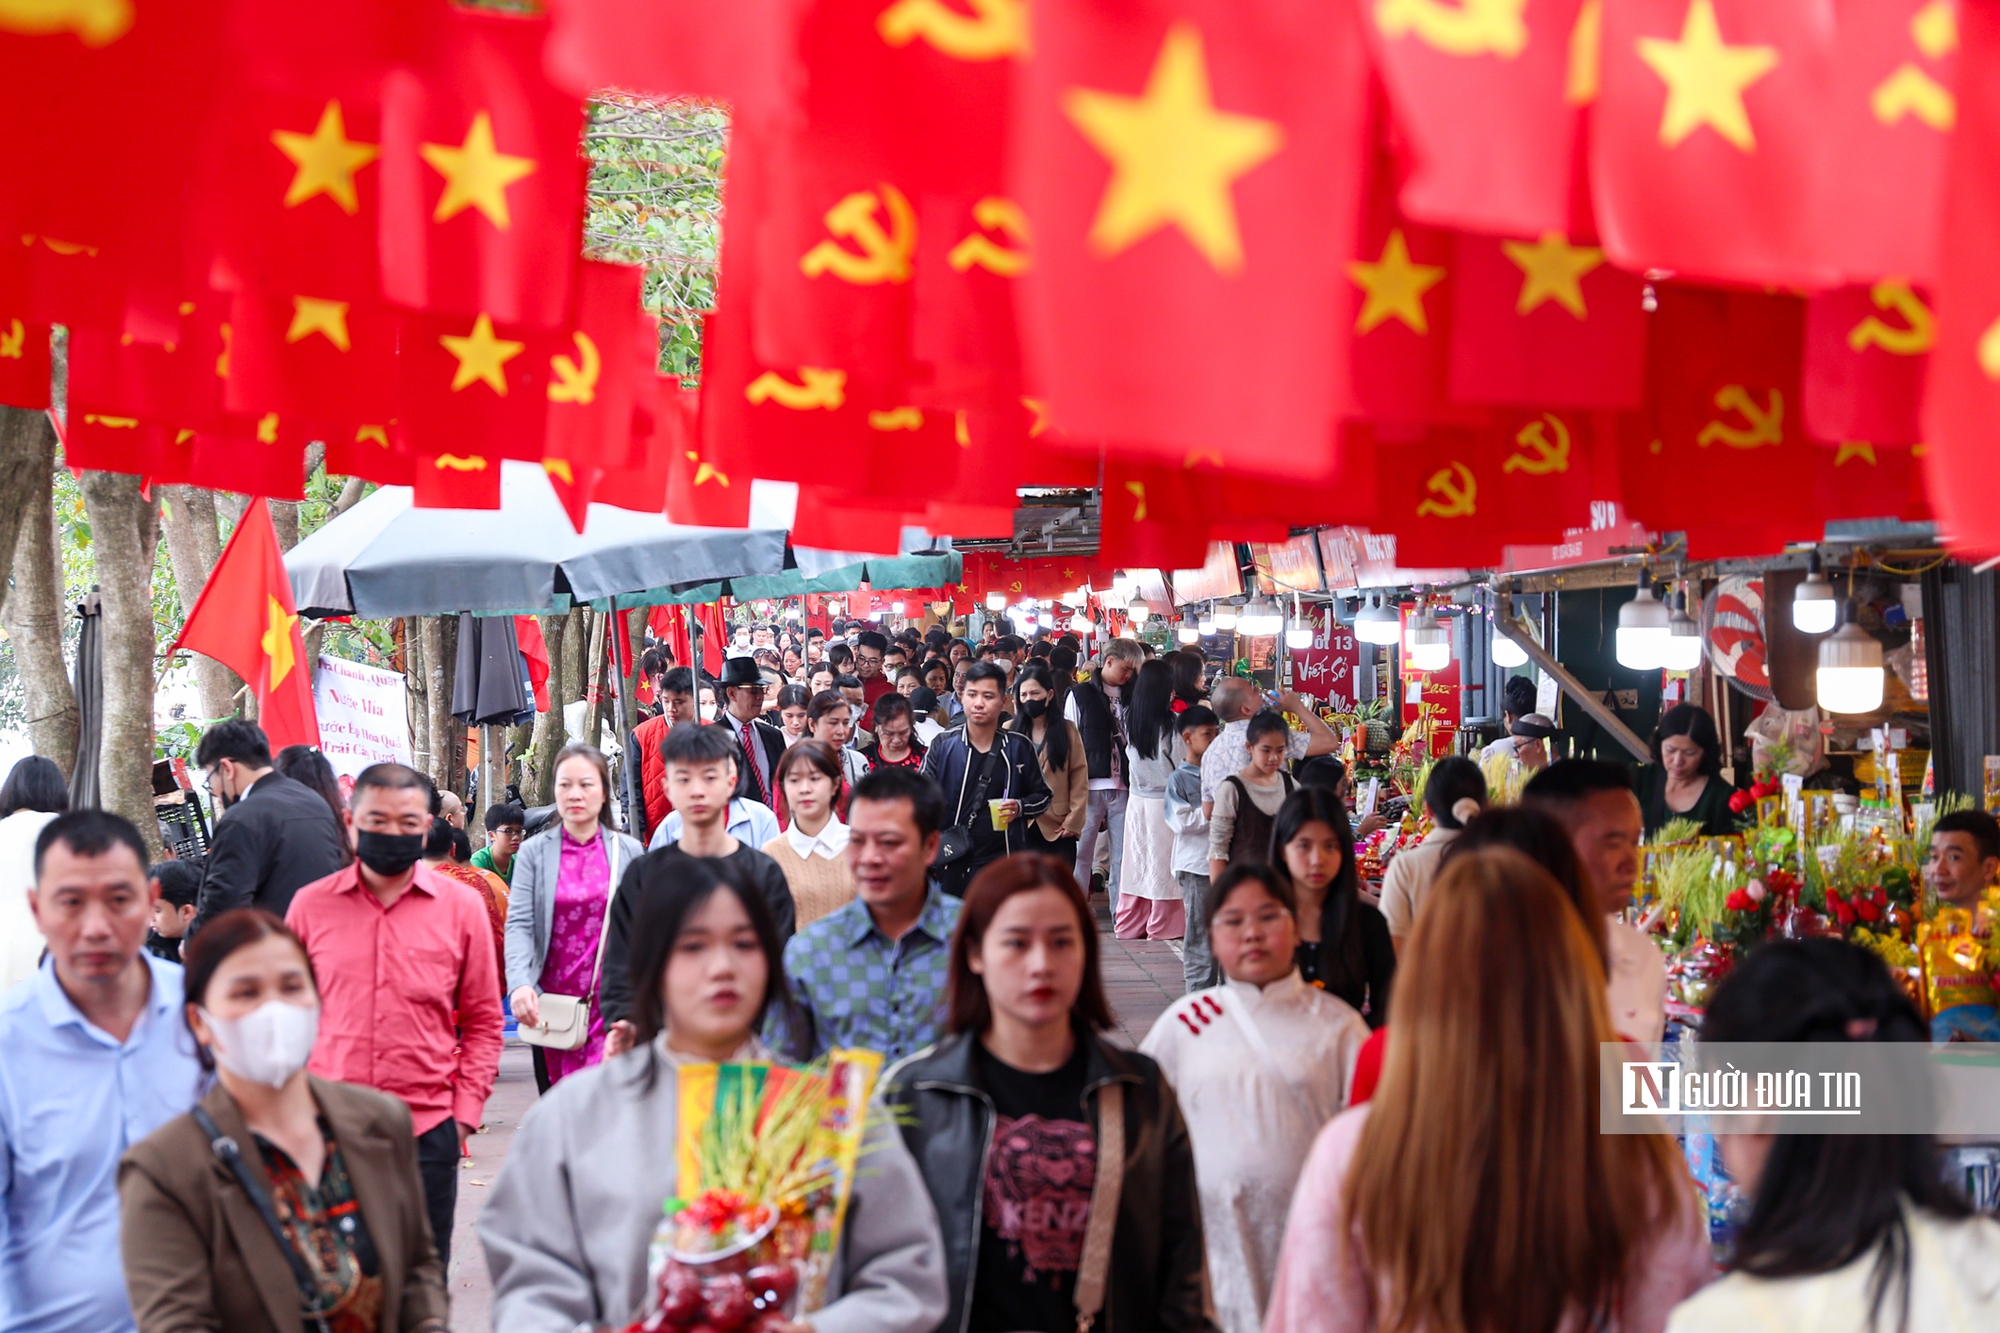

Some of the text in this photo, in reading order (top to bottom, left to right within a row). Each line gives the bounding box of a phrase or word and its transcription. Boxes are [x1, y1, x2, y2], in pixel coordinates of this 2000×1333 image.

[1334, 635, 1353, 651] 13
[334, 663, 365, 682] Chanh
[329, 689, 384, 717] Nước Mía
[318, 720, 346, 734] ước
[348, 721, 361, 739] Ép
[362, 729, 380, 744] Hoa
[322, 741, 350, 755] Trái
